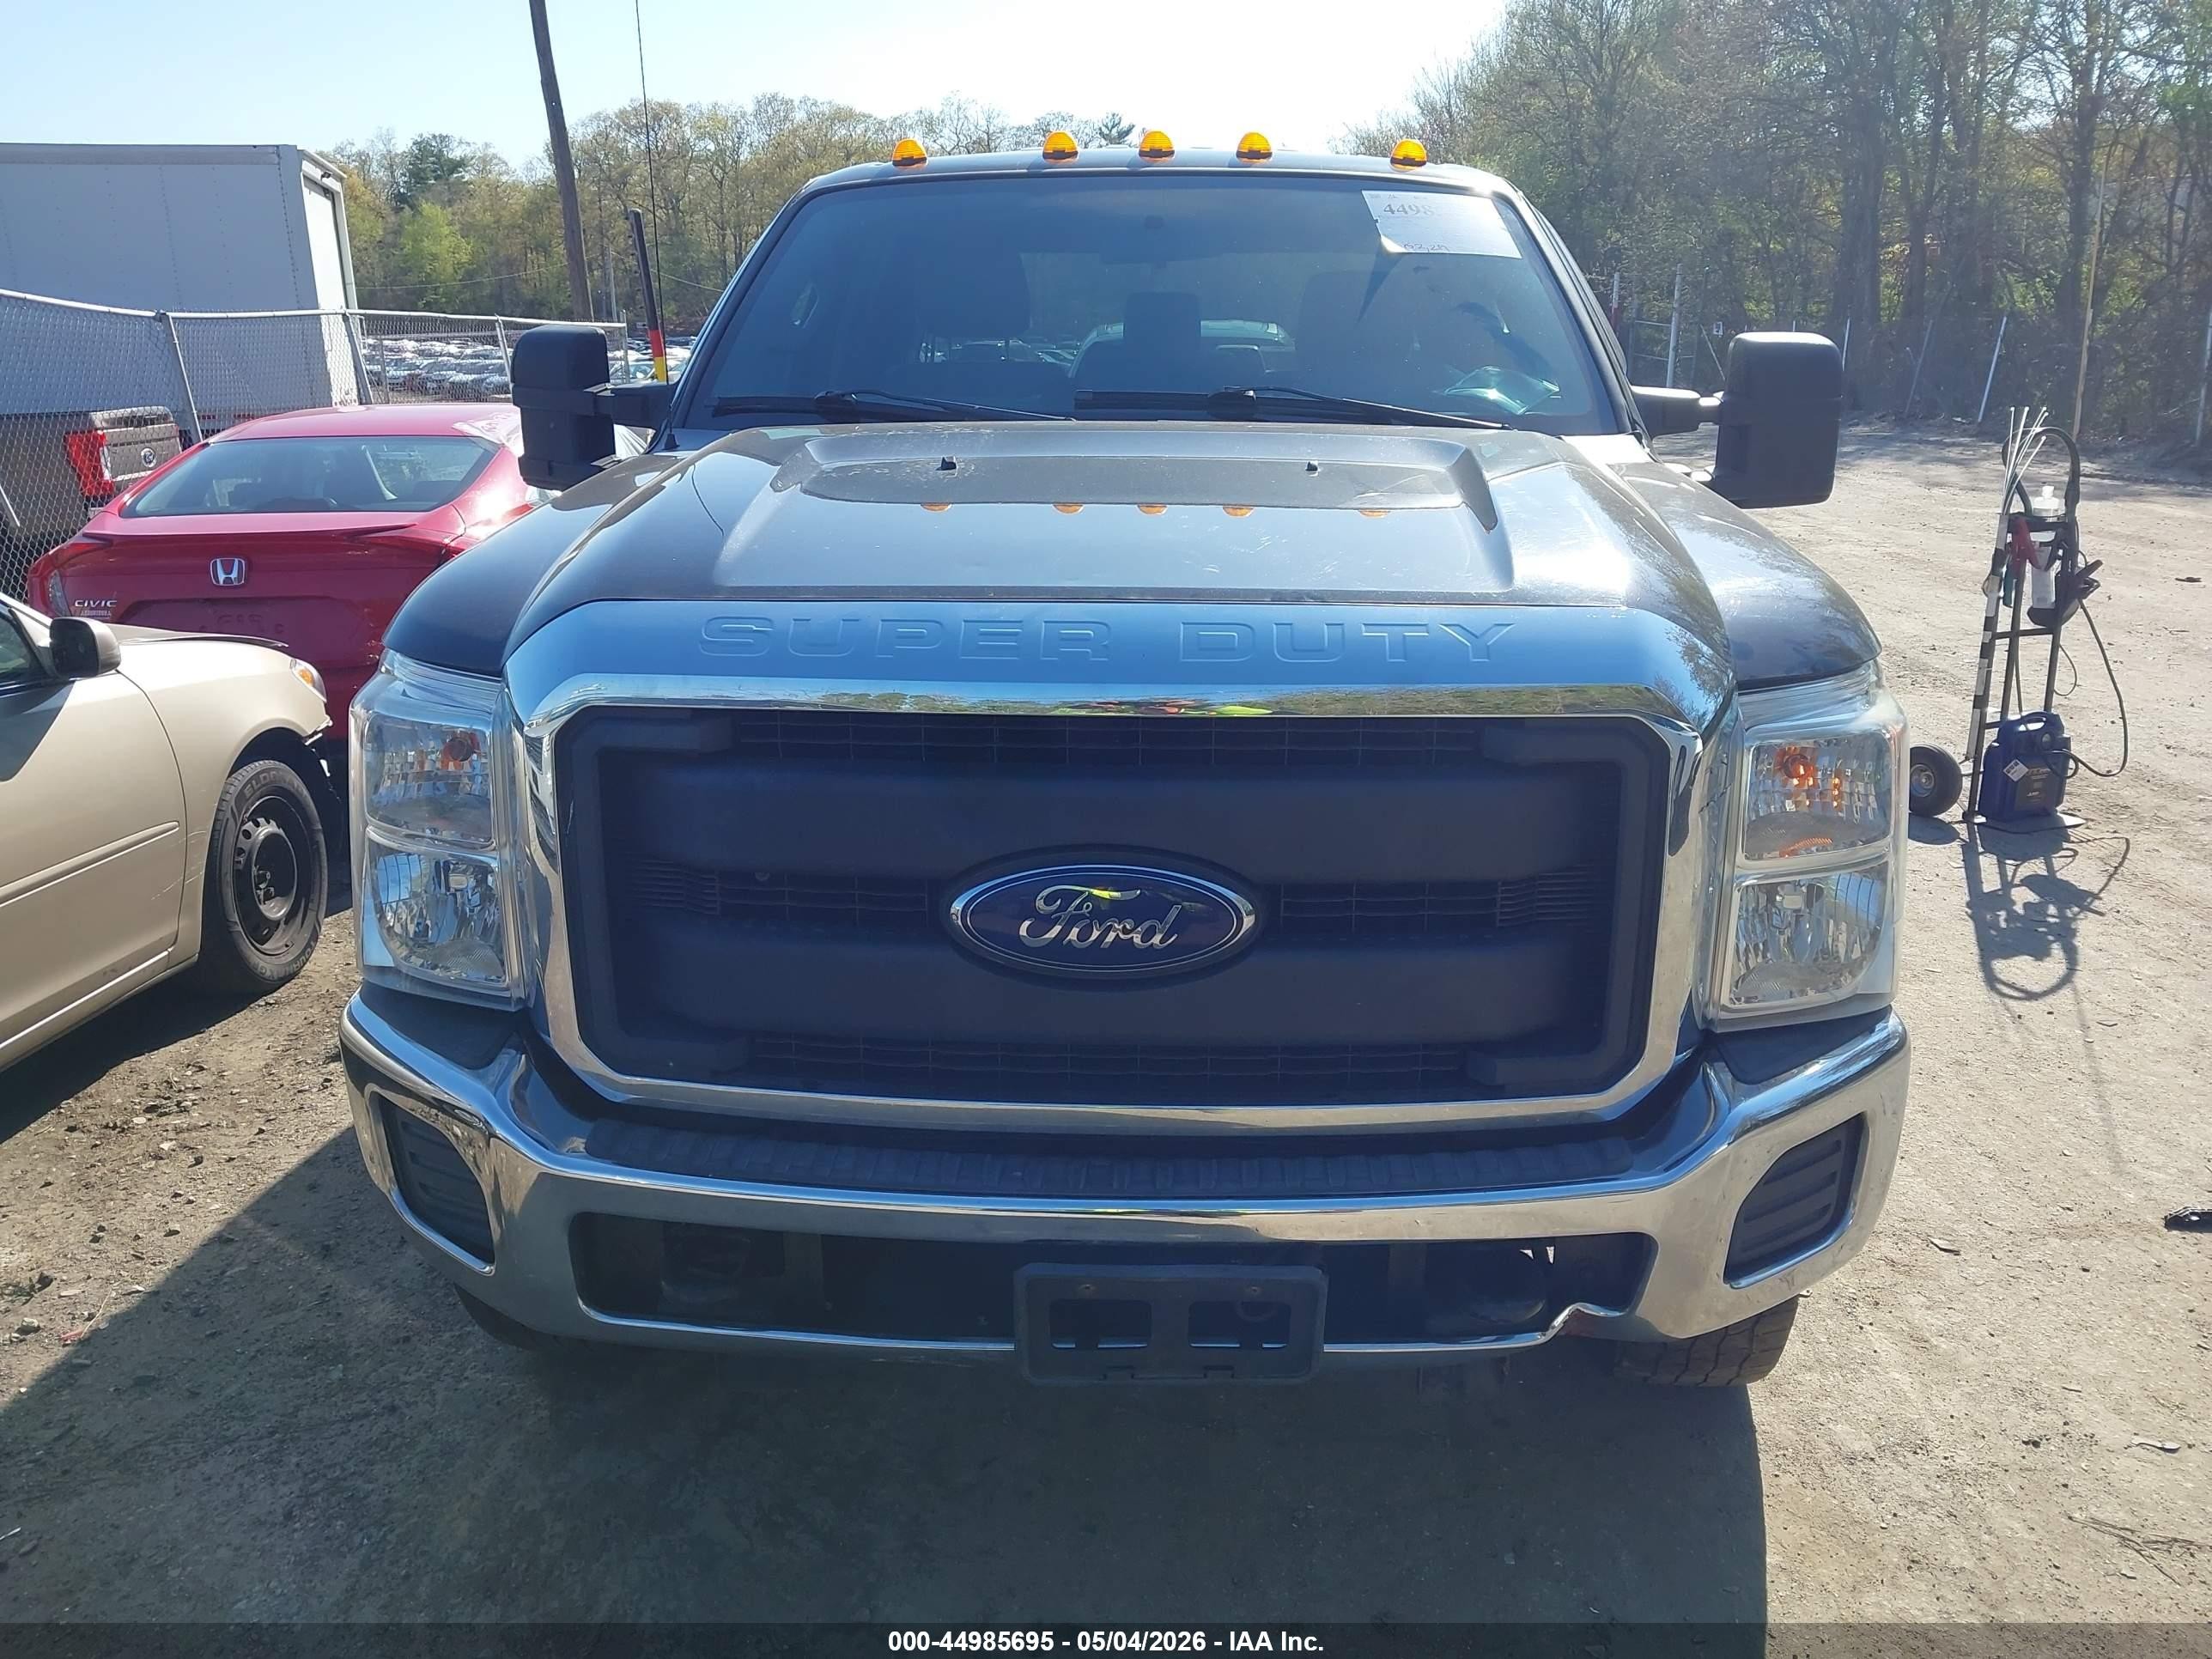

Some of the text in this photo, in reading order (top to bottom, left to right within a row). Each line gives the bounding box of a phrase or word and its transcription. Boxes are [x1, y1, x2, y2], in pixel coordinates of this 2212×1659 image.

[75, 599, 118, 608] CIVIC
[698, 616, 1516, 663] SUPER DUTY
[1018, 884, 1182, 950] Ford
